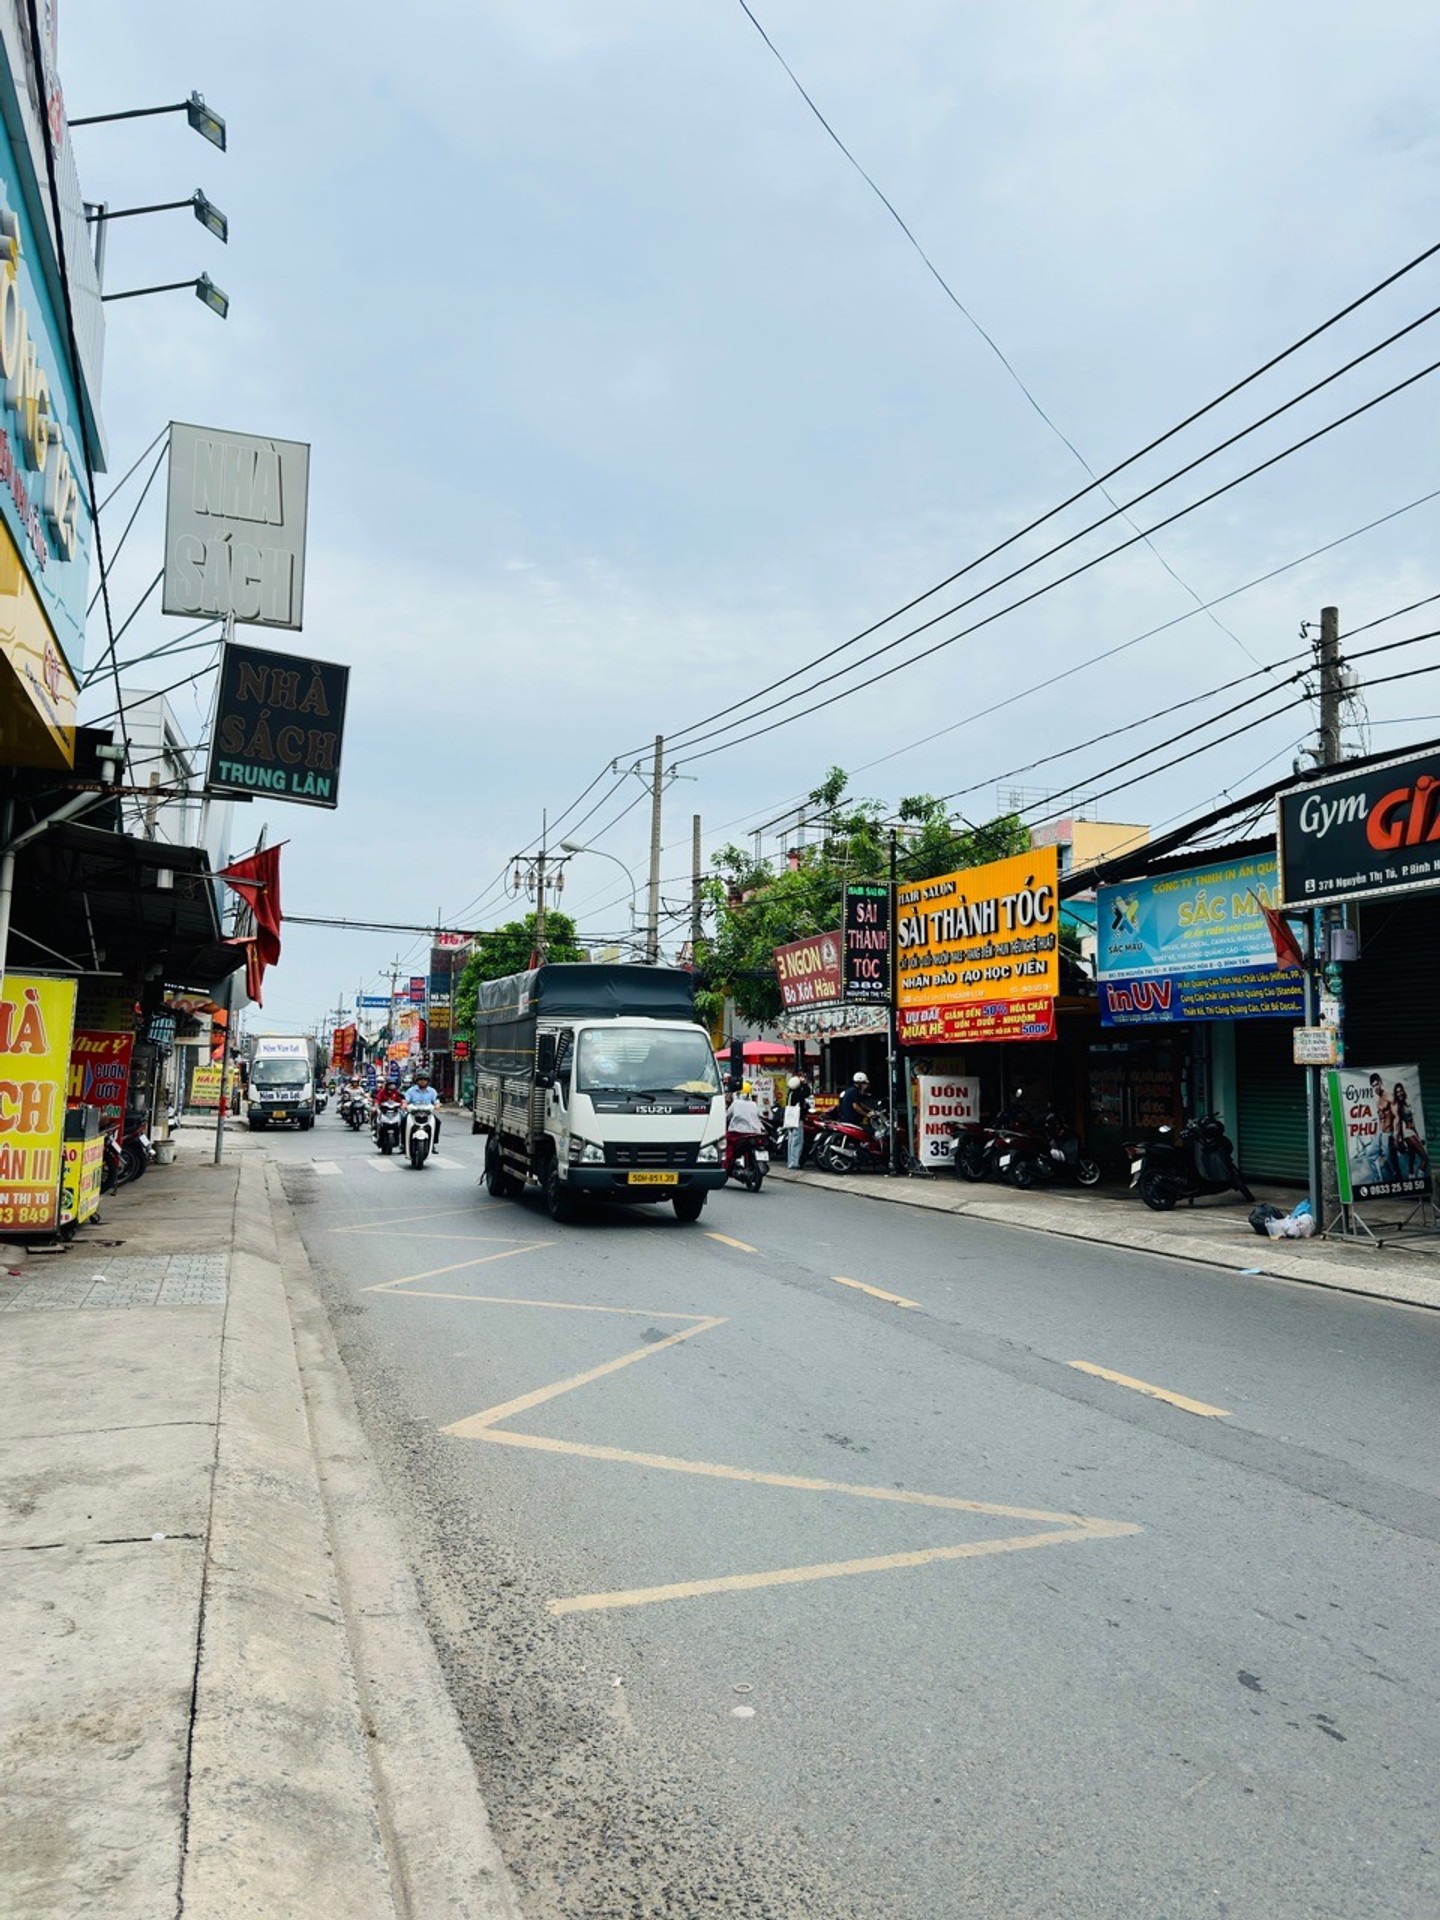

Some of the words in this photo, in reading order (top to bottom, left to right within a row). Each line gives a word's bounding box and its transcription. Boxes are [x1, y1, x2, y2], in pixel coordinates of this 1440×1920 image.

[194, 440, 284, 527] NHÀ
[175, 531, 294, 624] SÁCH
[236, 662, 330, 716] NHÀ
[219, 709, 337, 771] SÁCH
[218, 760, 286, 791] TRUNG
[291, 770, 331, 797] LÂN
[1299, 792, 1369, 838] Gym
[1225, 869, 1235, 880] IN
[1318, 879, 1334, 891] 378
[899, 890, 920, 906] HAIR
[923, 882, 956, 900] SALON
[856, 899, 878, 923] SÀI
[898, 906, 929, 948] SÀI
[930, 895, 999, 943] THÀNH
[1001, 874, 1054, 930] TÓC
[847, 926, 888, 949] THÀNH
[777, 955, 788, 980] 3
[785, 945, 822, 978] NGON
[853, 953, 880, 978] TÓC
[902, 973, 932, 991] NHẬN
[960, 968, 983, 986] TẠO
[984, 965, 1012, 982] HỌC
[1014, 957, 1048, 976] VIÊN
[814, 977, 836, 998] Hàu
[849, 981, 883, 990] 380
[1022, 1023, 1049, 1034] 500K
[95, 1059, 127, 1079] CUỐN
[930, 1083, 969, 1098] UỐN
[1345, 1084, 1374, 1103] Gym
[635, 1105, 673, 1114] ISUZU
[925, 1123, 954, 1135] NHU
[1348, 1116, 1379, 1137] PHÚ
[14, 1193, 32, 1207] THỊ
[19, 1207, 49, 1223] 849
